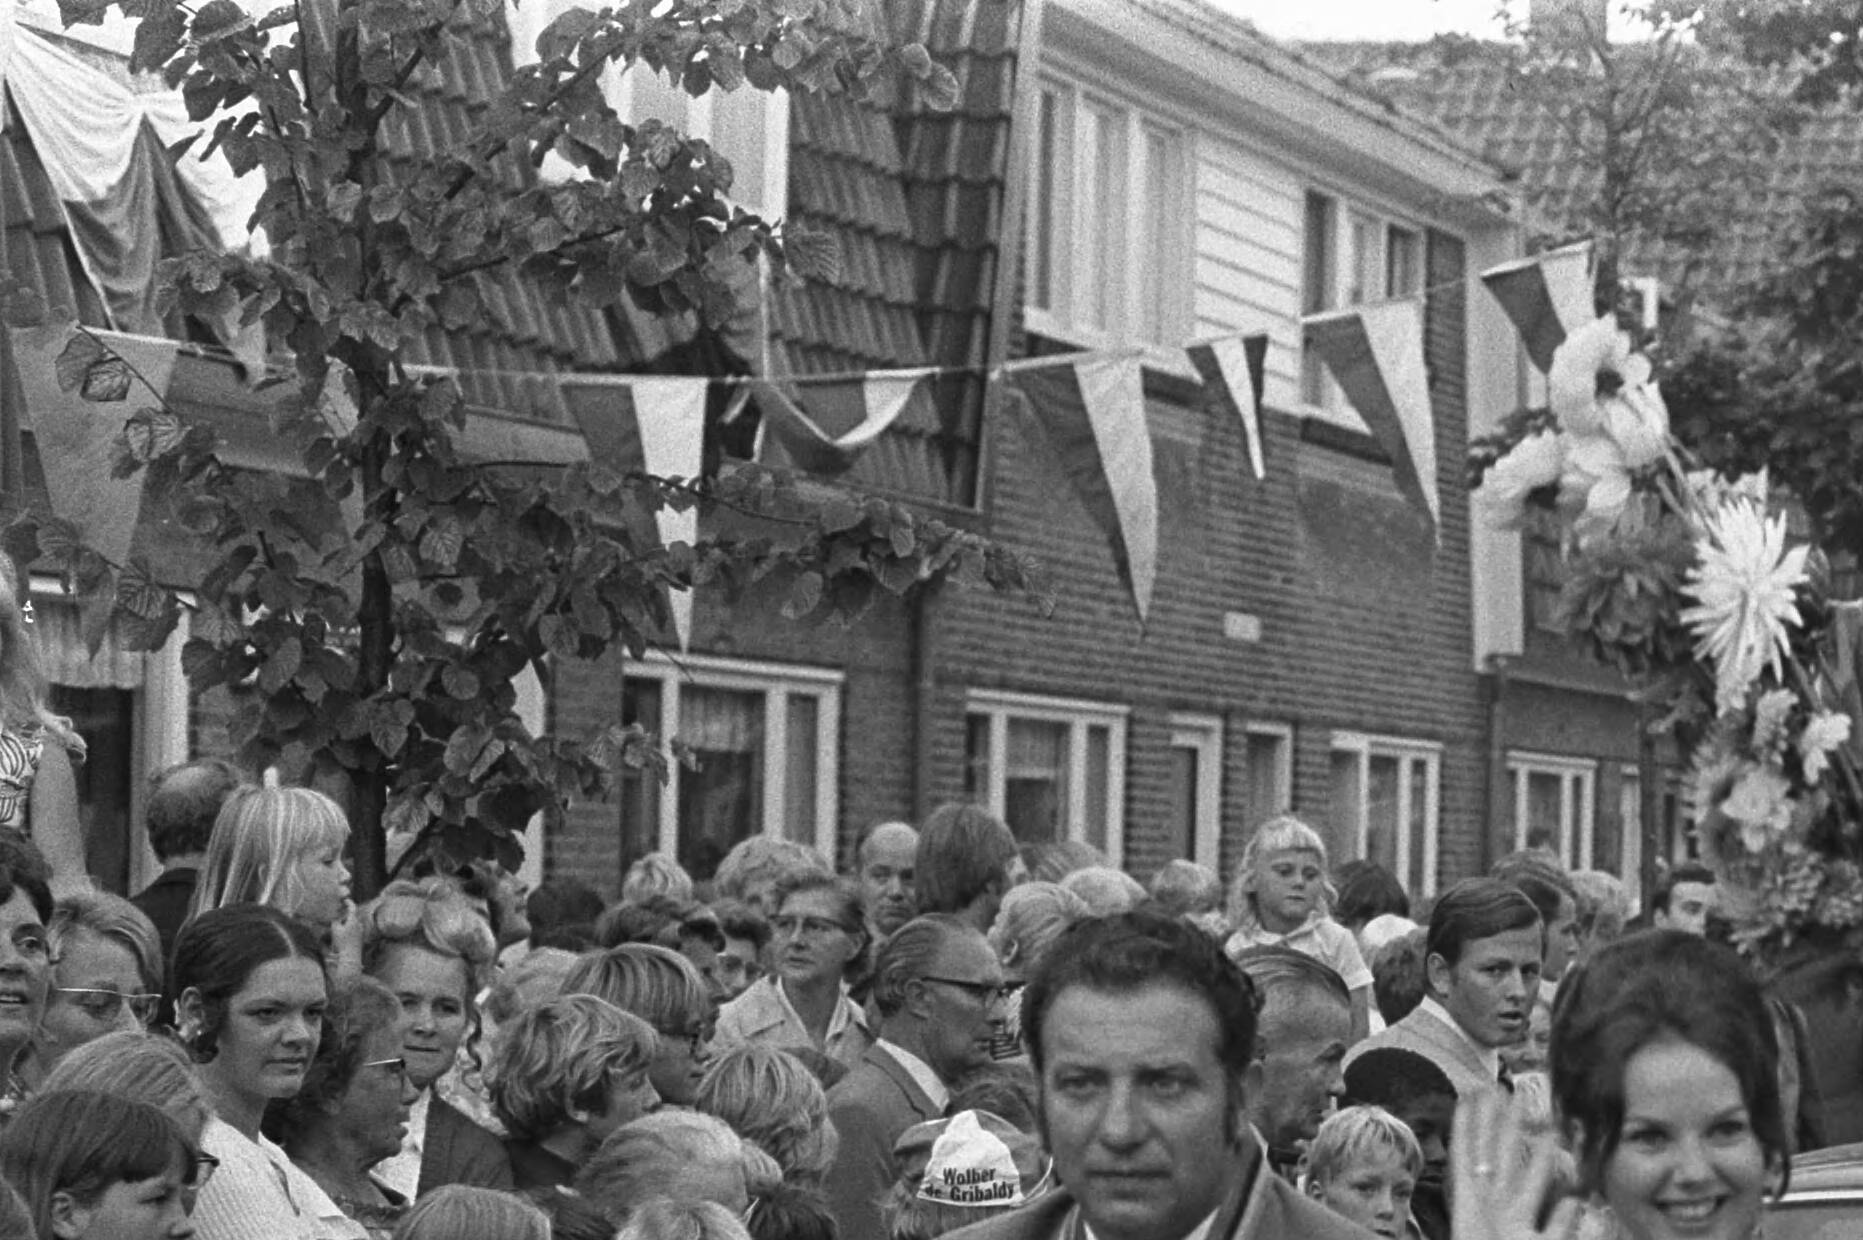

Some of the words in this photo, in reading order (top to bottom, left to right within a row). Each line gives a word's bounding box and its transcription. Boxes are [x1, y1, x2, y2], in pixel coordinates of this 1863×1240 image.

[943, 1168, 996, 1185] Wolber
[925, 1185, 941, 1198] de
[951, 1182, 1014, 1201] Gribaldy
